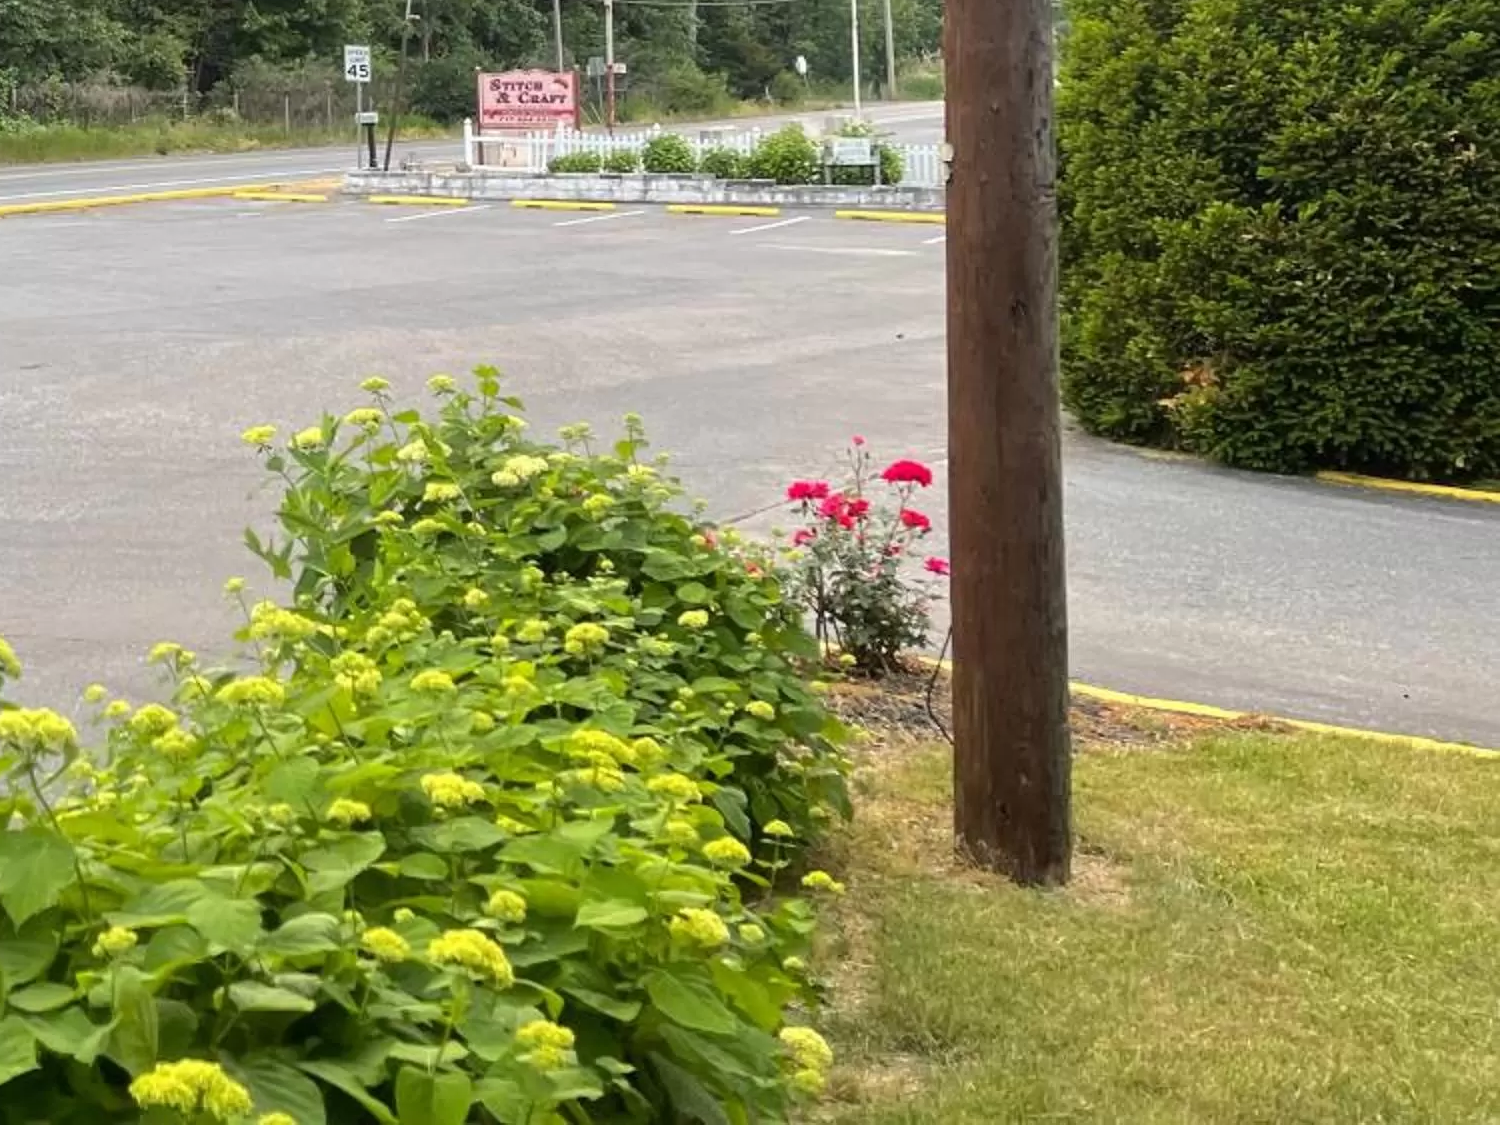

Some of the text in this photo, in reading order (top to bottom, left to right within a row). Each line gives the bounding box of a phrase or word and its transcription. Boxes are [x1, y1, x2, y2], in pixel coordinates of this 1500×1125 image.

[347, 64, 368, 77] 45
[489, 78, 543, 91] STITCH
[496, 91, 567, 104] & CRAFT
